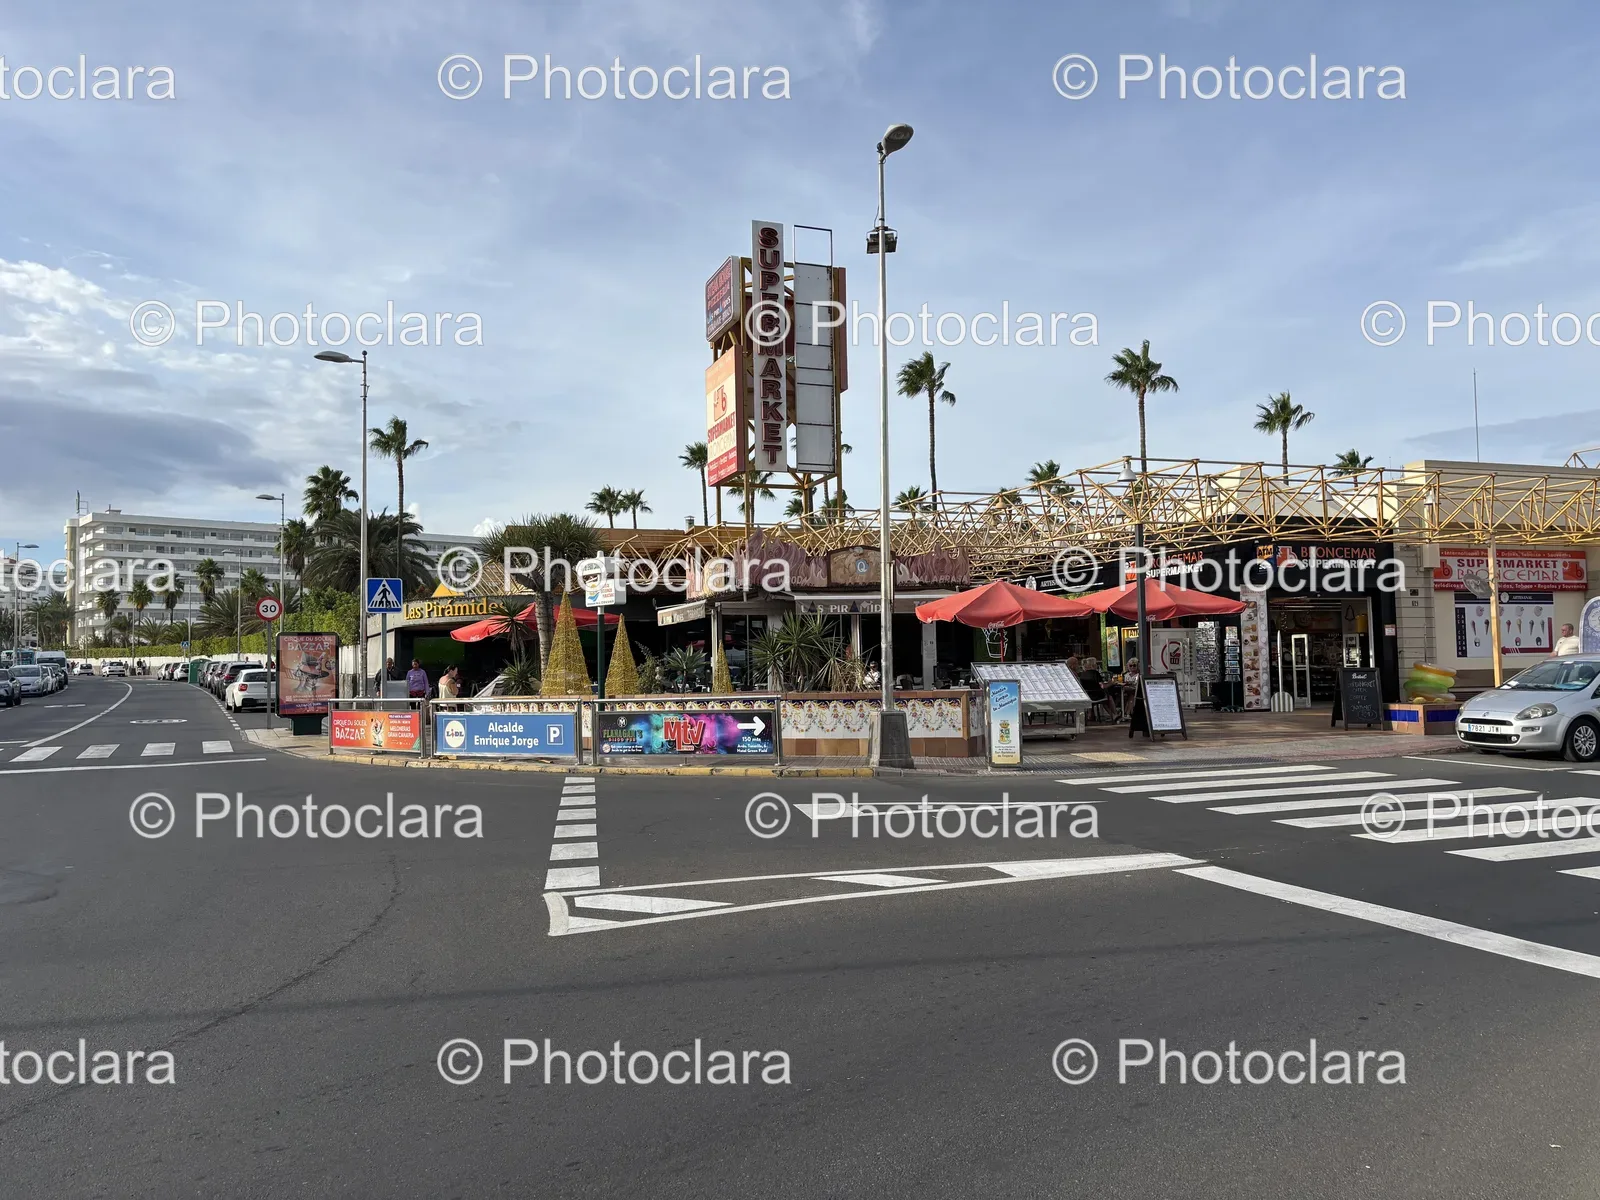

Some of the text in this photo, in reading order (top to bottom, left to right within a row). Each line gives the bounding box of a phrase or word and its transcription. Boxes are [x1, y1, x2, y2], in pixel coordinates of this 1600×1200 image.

[757, 226, 784, 466] SUPERMARKET
[708, 411, 736, 443] SUPERMARKET
[1257, 546, 1274, 557] ATM
[1301, 547, 1376, 558] BRONCEMAR
[1302, 559, 1376, 569] SUPERMARKET
[1457, 558, 1558, 569] SUPRMARKET
[1145, 562, 1204, 578] SUPERMARKET
[262, 604, 277, 613] 30
[404, 603, 422, 620] Las
[287, 642, 331, 651] BAZZAR
[333, 719, 348, 727] CIRQUE
[488, 722, 524, 733] Alcalde
[335, 727, 366, 740] BAZZAR
[474, 735, 539, 748] Enrique Jorge
